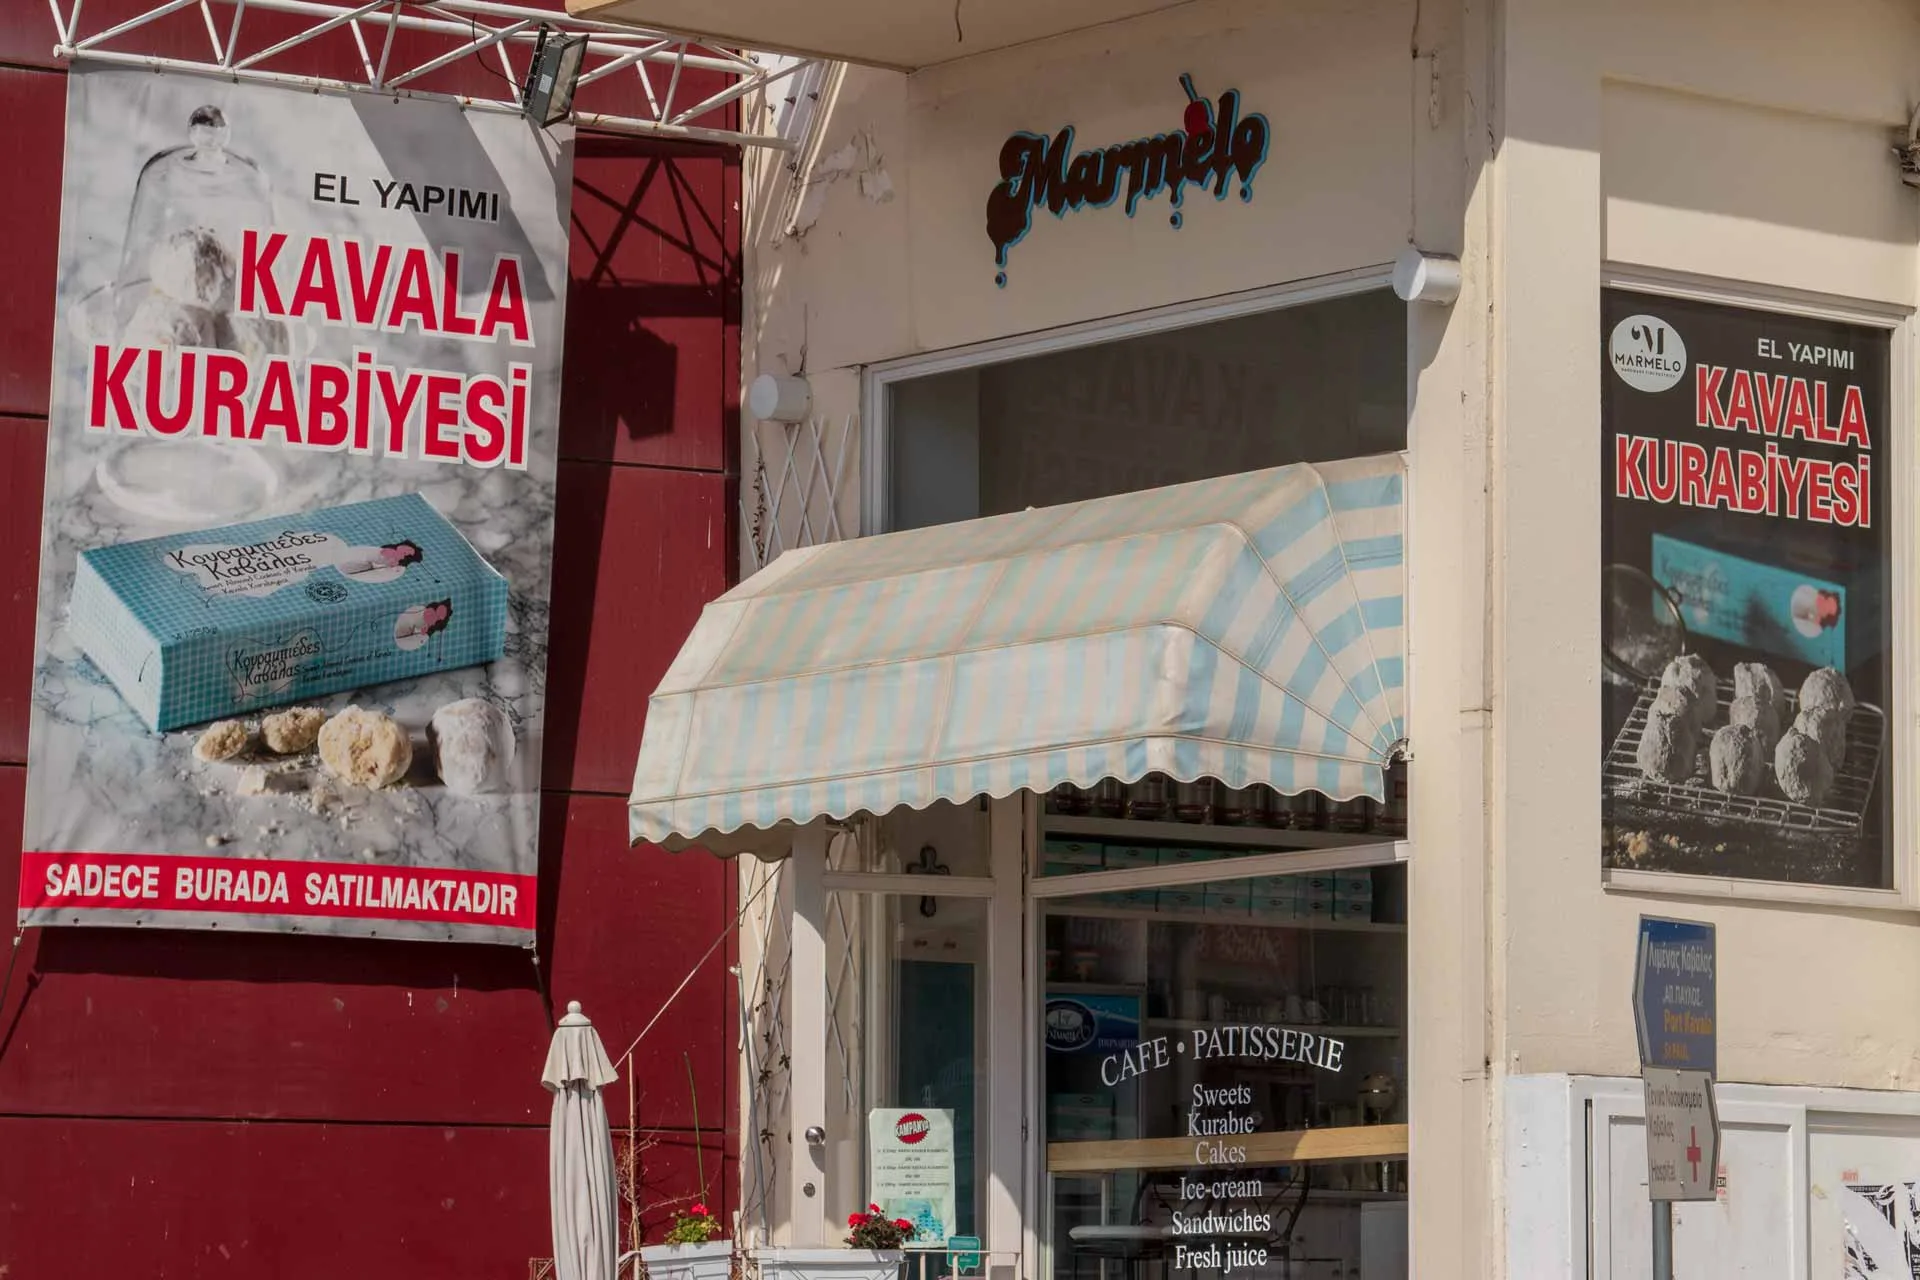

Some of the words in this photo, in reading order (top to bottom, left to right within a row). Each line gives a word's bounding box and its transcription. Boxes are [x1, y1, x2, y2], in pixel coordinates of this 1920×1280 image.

[313, 172, 361, 206] EL
[373, 179, 501, 223] YAPIMI
[986, 82, 1270, 275] Marmelo
[237, 228, 533, 345] KAVALA
[1615, 353, 1682, 372] MARMELO
[1757, 338, 1784, 360] EL
[1788, 341, 1856, 371] YAPIMI
[90, 342, 529, 467] KURABİYESİ
[1695, 363, 1873, 450] KAVALA
[1615, 432, 1873, 529] KURABİYESİ
[45, 863, 161, 900] SADECE
[174, 867, 290, 904] BURADA
[304, 871, 519, 916] SATILMAKTADIR
[1100, 1037, 1170, 1087] CAFE
[1192, 1026, 1345, 1073] PATISSERIE
[1192, 1083, 1252, 1108] Sweets
[1194, 1140, 1247, 1166] Cakes
[1179, 1176, 1263, 1202] Ice-cream
[1171, 1207, 1272, 1237] Sandwiches
[1174, 1243, 1222, 1271] Fresh
[1223, 1240, 1268, 1274] juice
